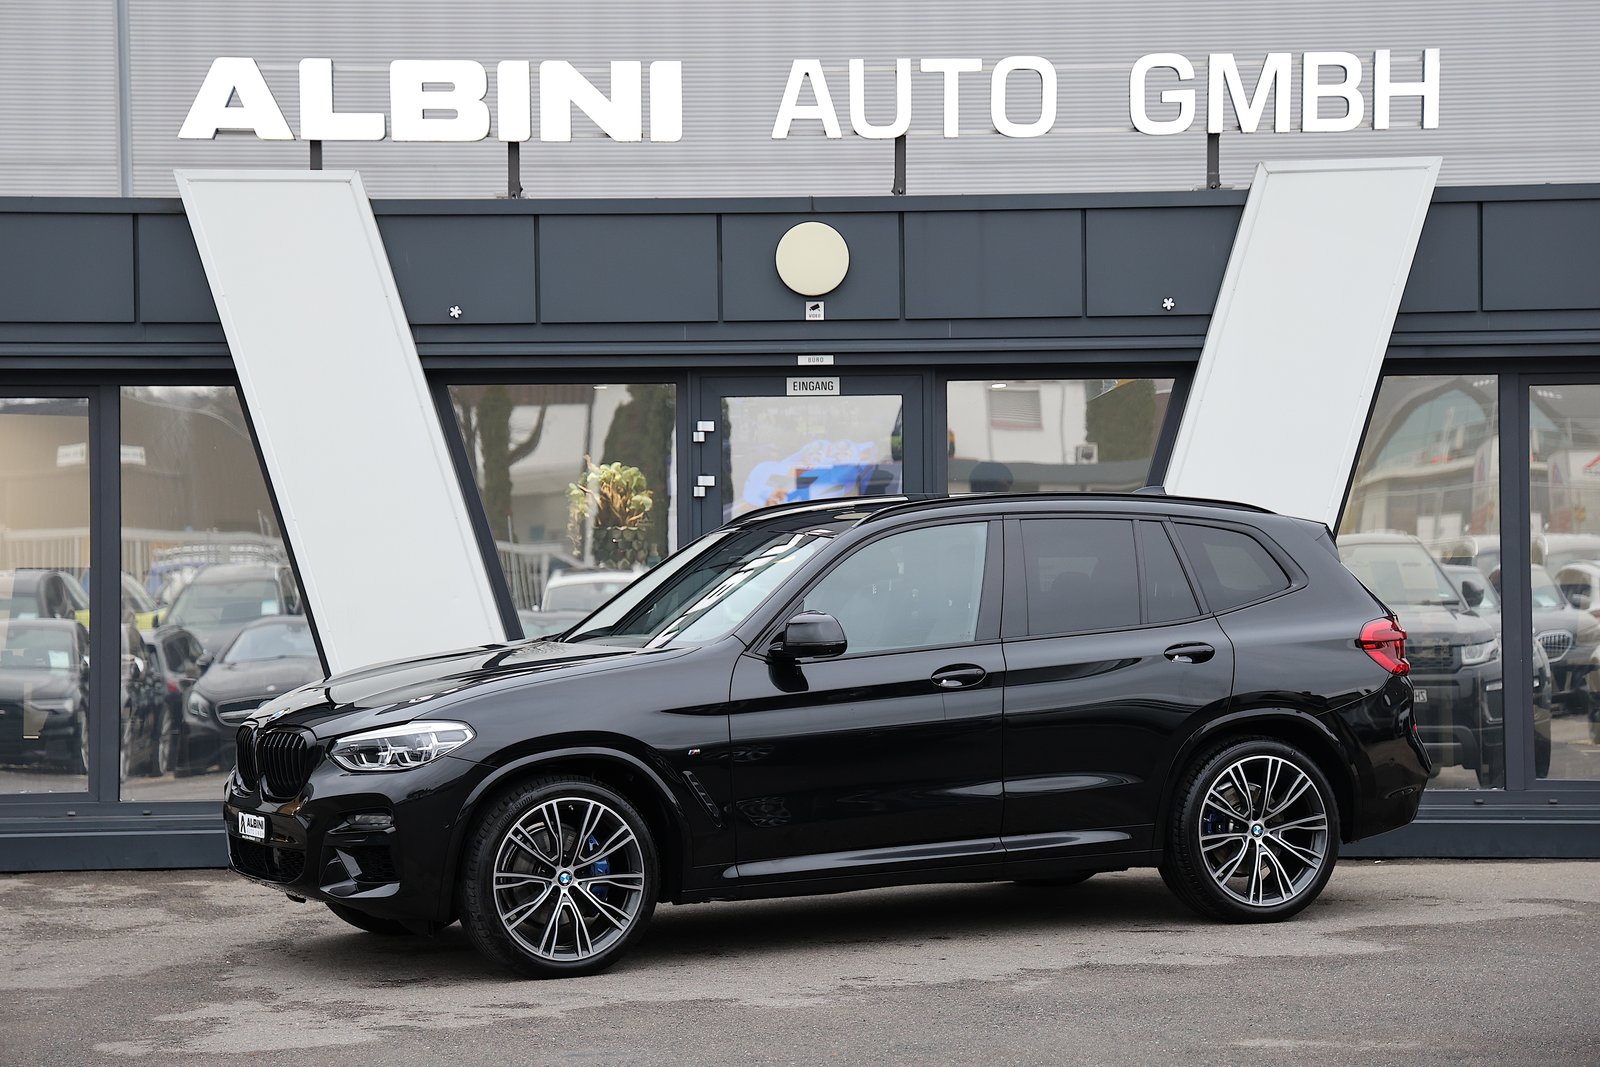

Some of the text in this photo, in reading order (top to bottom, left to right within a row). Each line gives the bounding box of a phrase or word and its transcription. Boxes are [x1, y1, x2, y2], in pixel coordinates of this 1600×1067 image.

[177, 48, 1440, 143] ALBINI AUTO GMBH
[792, 380, 834, 391] EINGANG
